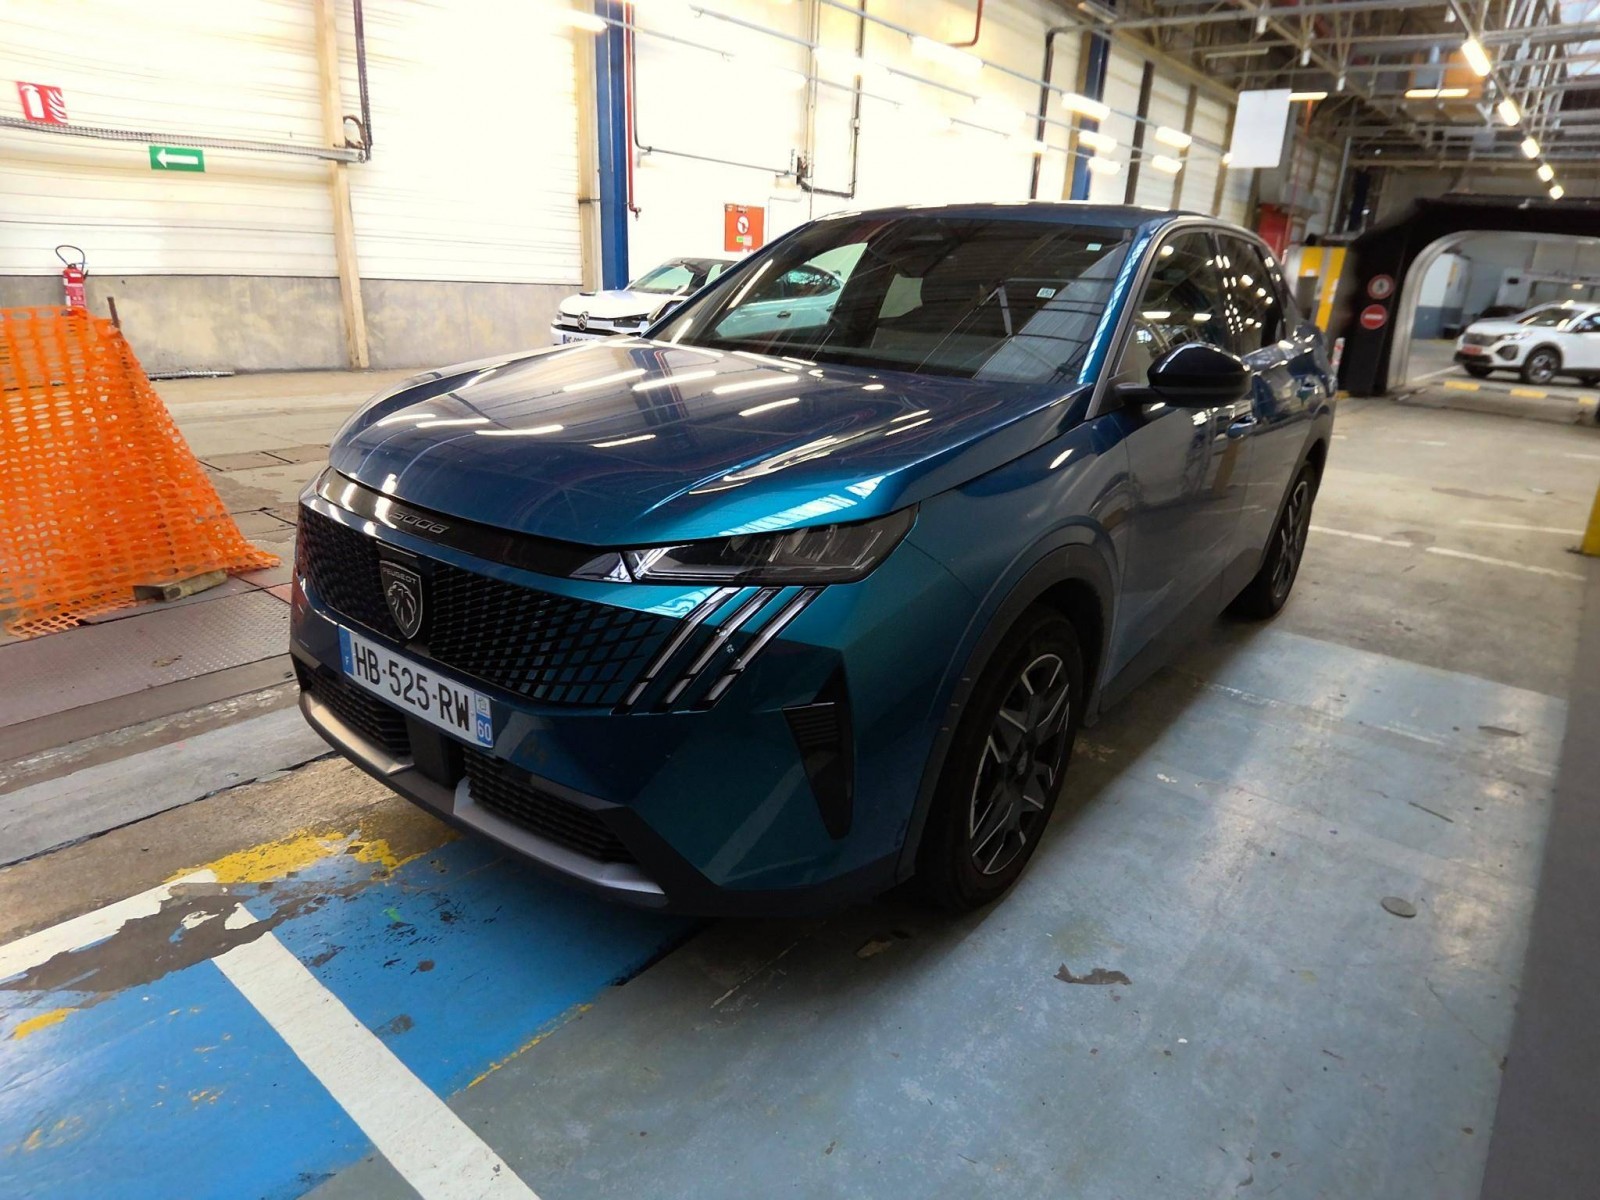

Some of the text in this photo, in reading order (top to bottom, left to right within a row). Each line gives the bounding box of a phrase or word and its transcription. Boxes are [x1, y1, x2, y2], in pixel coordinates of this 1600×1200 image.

[382, 567, 416, 584] PEUGEOT
[354, 642, 470, 731] HB-525-RW
[477, 719, 492, 741] 60
